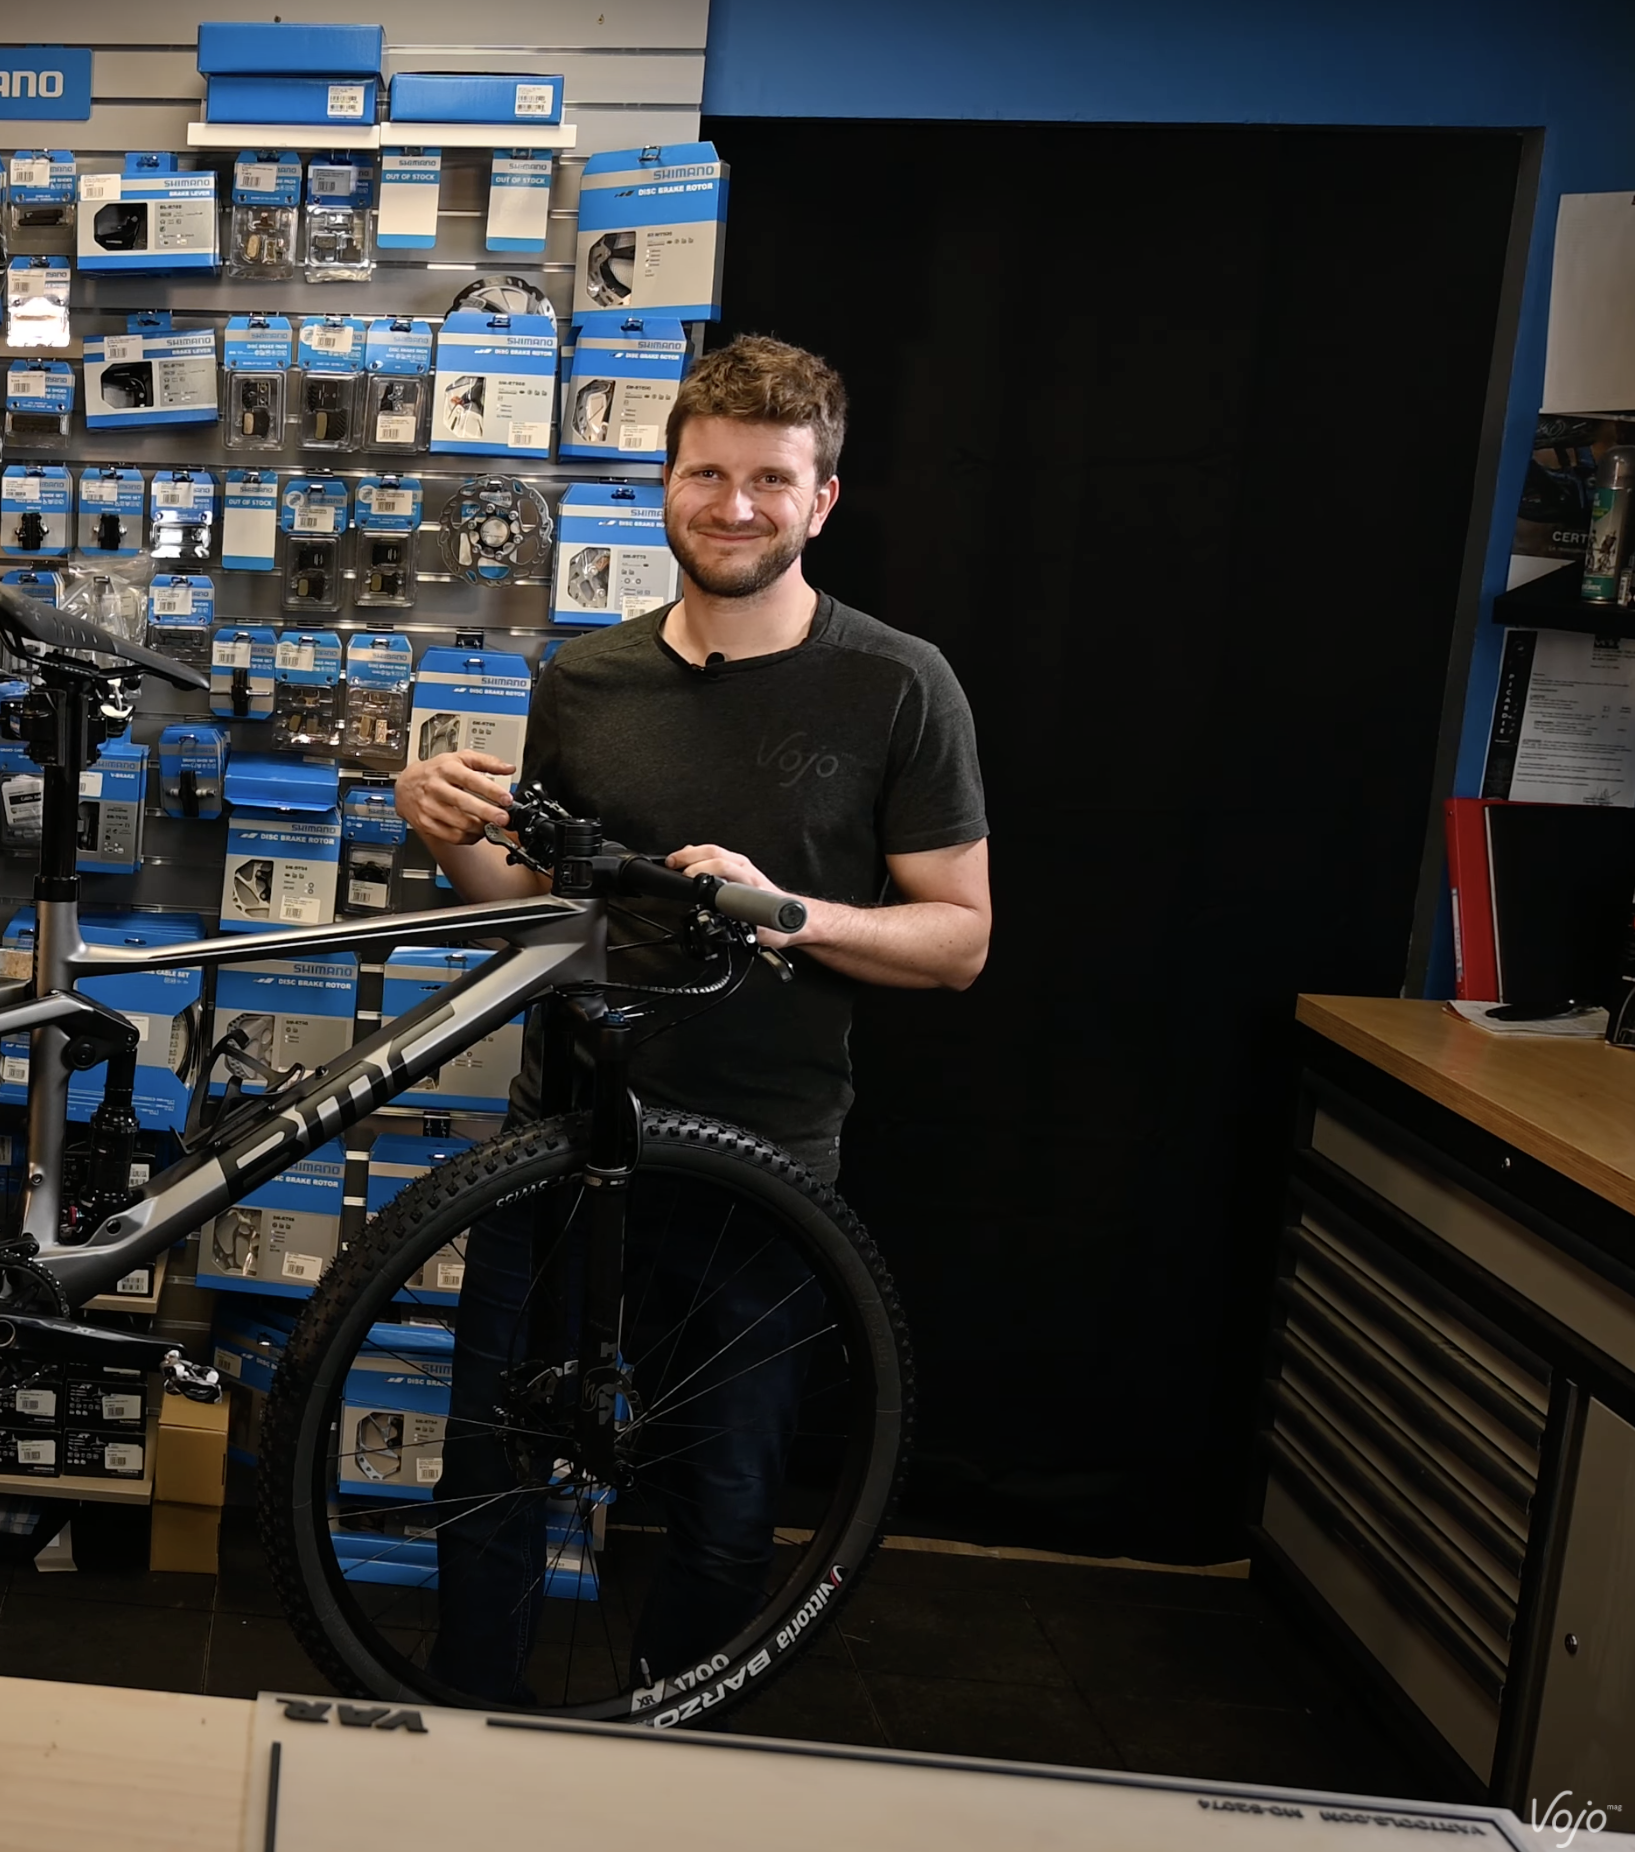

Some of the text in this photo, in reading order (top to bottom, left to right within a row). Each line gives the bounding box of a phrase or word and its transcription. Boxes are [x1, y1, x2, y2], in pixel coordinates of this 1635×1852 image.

[399, 159, 436, 167] SHIMANO
[385, 173, 400, 181] OUT
[412, 174, 435, 182] STOCK
[653, 166, 715, 181] SHIMANO
[163, 179, 210, 187] SHIMANO
[511, 176, 520, 184] OF
[522, 177, 546, 185] STOCK
[638, 183, 713, 196] DISC BRAKE ROTOR
[166, 337, 211, 346] SHIMANO
[507, 337, 553, 346] SHIMANO
[637, 341, 682, 350] SHIMANO
[481, 677, 527, 687] SHIMANO
[505, 689, 526, 697] ROTOR
[757, 731, 840, 788] Vojo
[110, 772, 135, 780] V-BRAKE
[291, 824, 337, 834] SHIMANO
[260, 833, 335, 845] DISC BRAKE ROTOR
[155, 969, 191, 978] CABLE SET
[293, 963, 353, 977] SHIMANO
[278, 977, 352, 990] DISC BRAKE ROTOR
[285, 1176, 339, 1188] BRAKE ROTOR
[407, 1377, 424, 1385] DISC
[673, 1653, 731, 1692] 1700
[653, 1648, 772, 1730] BARZO
[635, 1694, 657, 1708] XR
[276, 1697, 429, 1734] VAR
